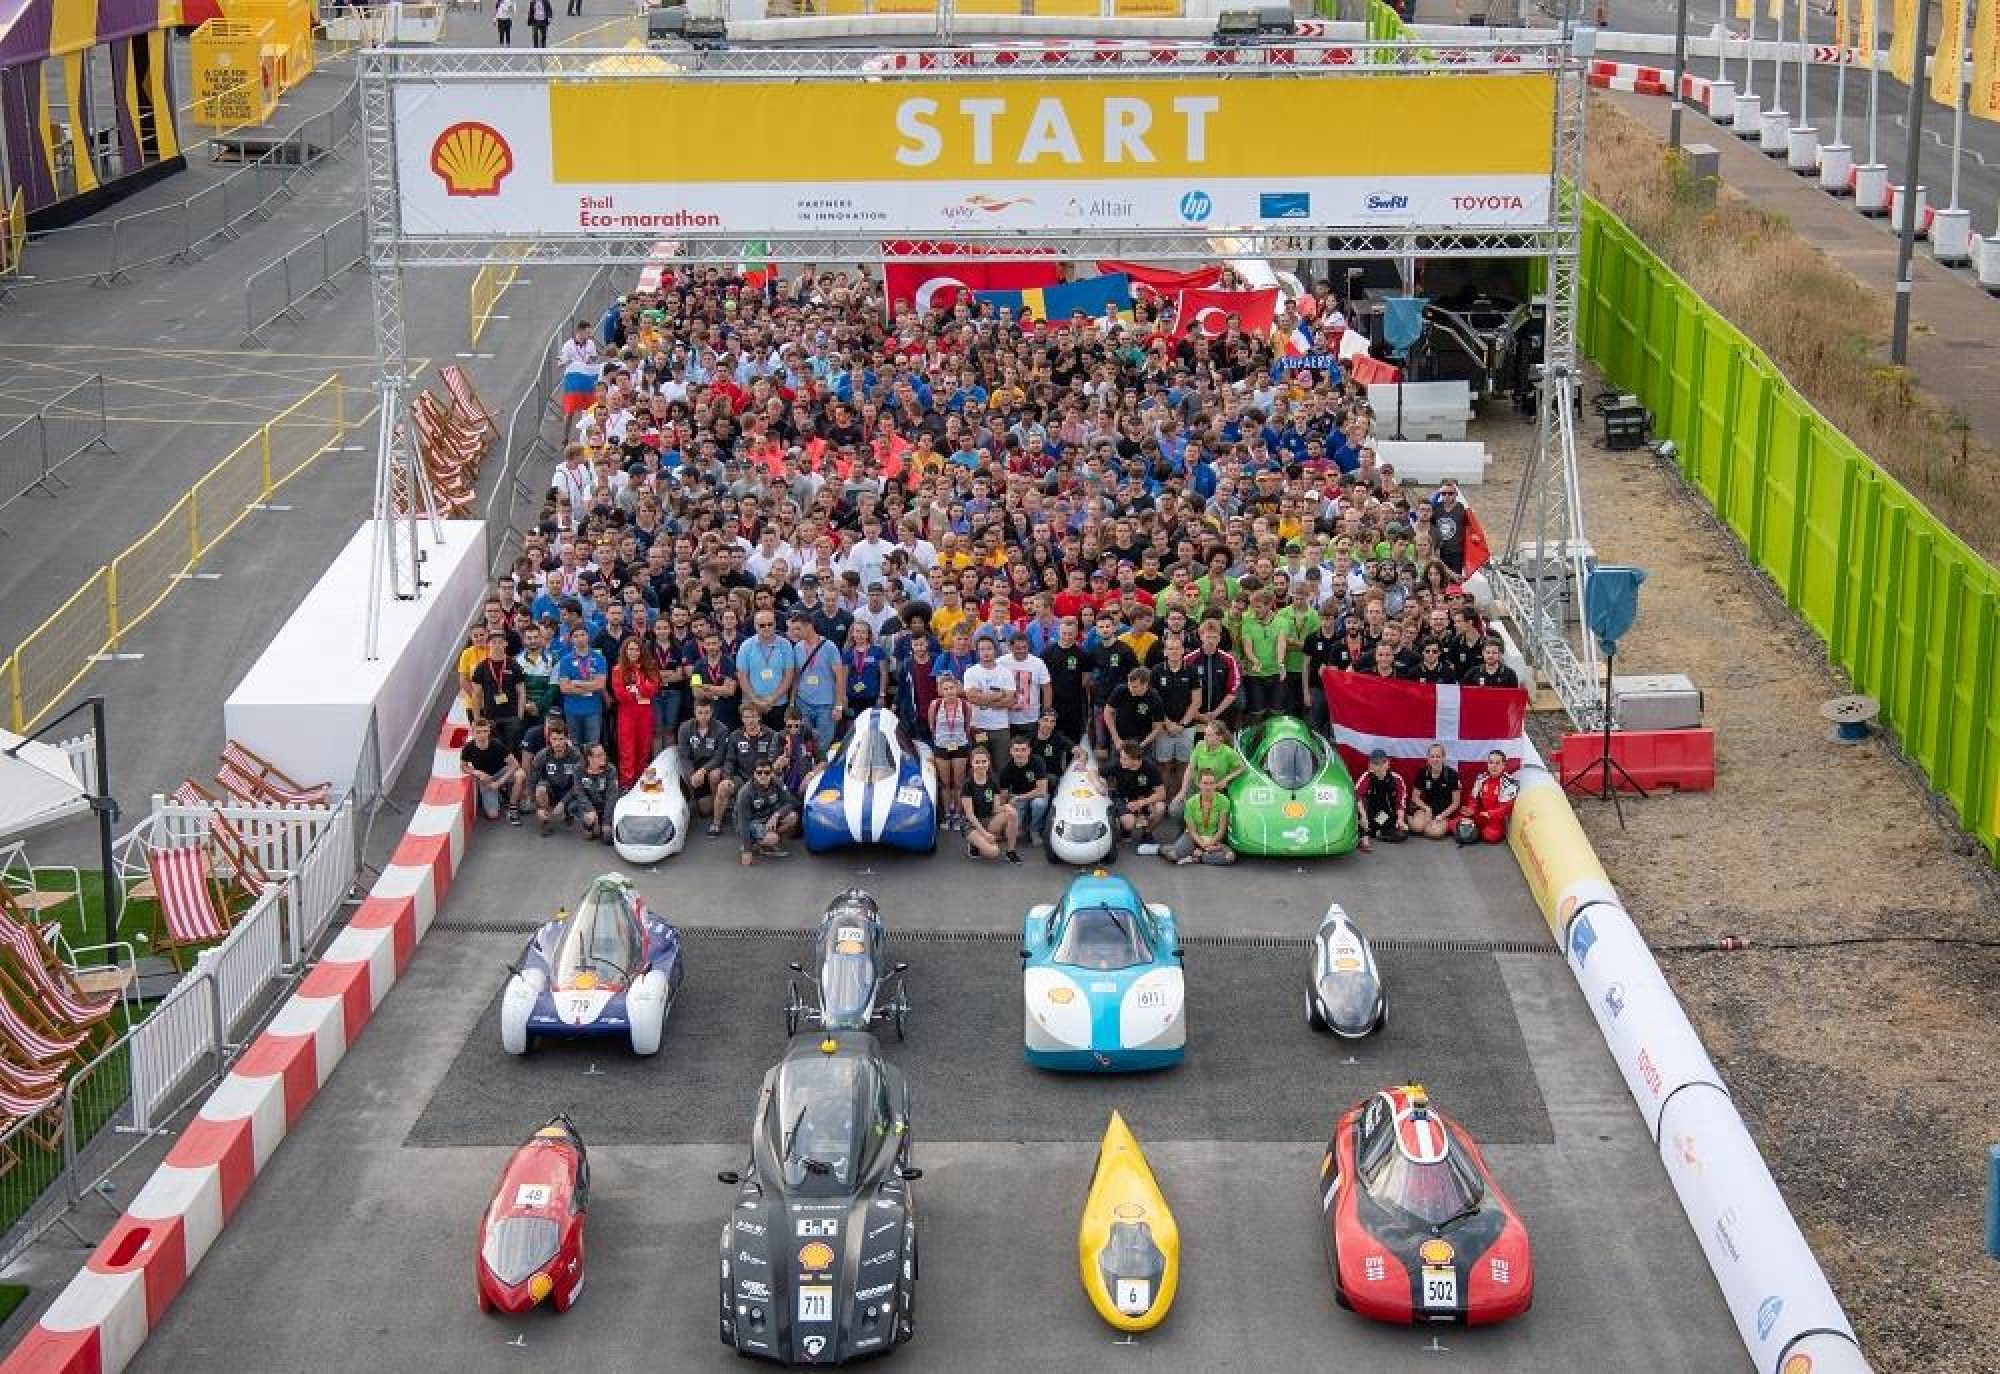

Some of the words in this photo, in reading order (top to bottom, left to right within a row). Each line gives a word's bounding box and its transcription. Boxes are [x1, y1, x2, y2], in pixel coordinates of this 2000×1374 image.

[895, 96, 1219, 166] START
[580, 195, 613, 209] Shell
[797, 199, 852, 209] PARTNERS
[1089, 198, 1133, 217] Altair
[1182, 191, 1212, 222] hp
[1367, 194, 1409, 209] SwRI
[1453, 195, 1523, 211] TOYOTA
[580, 209, 720, 227] Eco-marathon
[797, 211, 811, 221] IN
[815, 211, 887, 221] INNOVATION
[1637, 1047, 1663, 1095] TOYOTA
[524, 1189, 543, 1201] 48
[1128, 1286, 1137, 1303] 6
[1428, 1281, 1453, 1301] 502
[804, 1295, 825, 1315] 711
